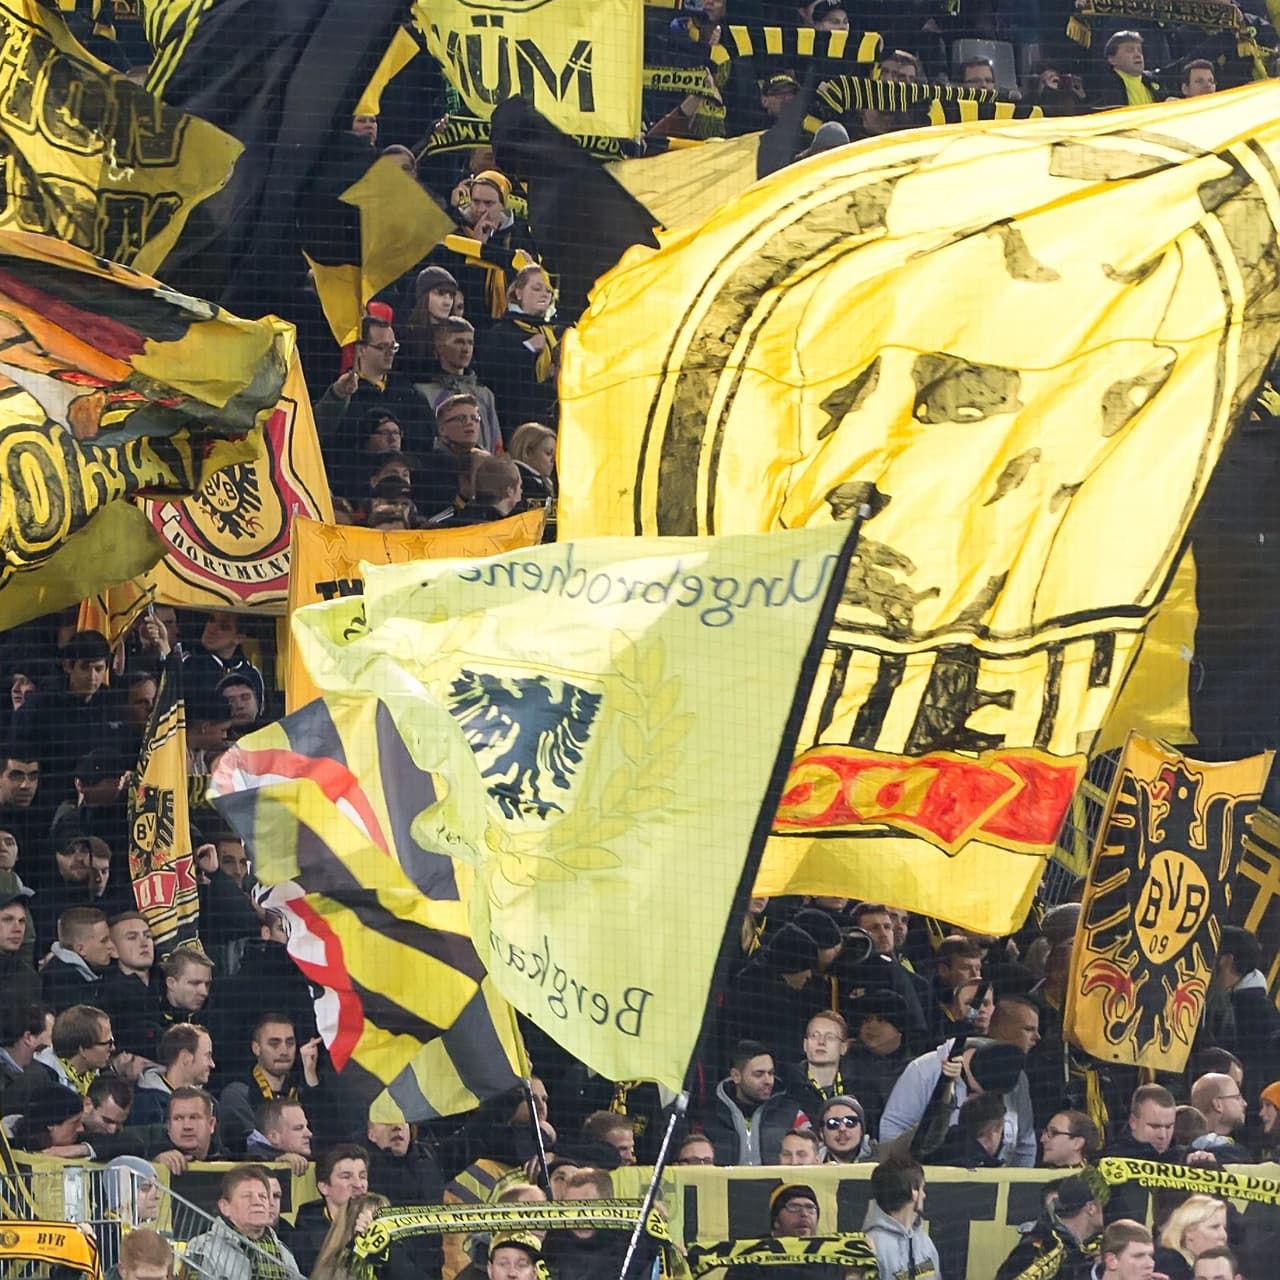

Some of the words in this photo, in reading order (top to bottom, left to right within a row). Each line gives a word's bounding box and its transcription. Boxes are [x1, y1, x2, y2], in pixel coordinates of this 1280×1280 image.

[1137, 864, 1211, 938] BVB
[1125, 1160, 1240, 1187] BORUSSIA
[1138, 1177, 1218, 1194] CHAMPIONS
[451, 1210, 509, 1225] NEVER
[517, 1207, 571, 1221] WALK
